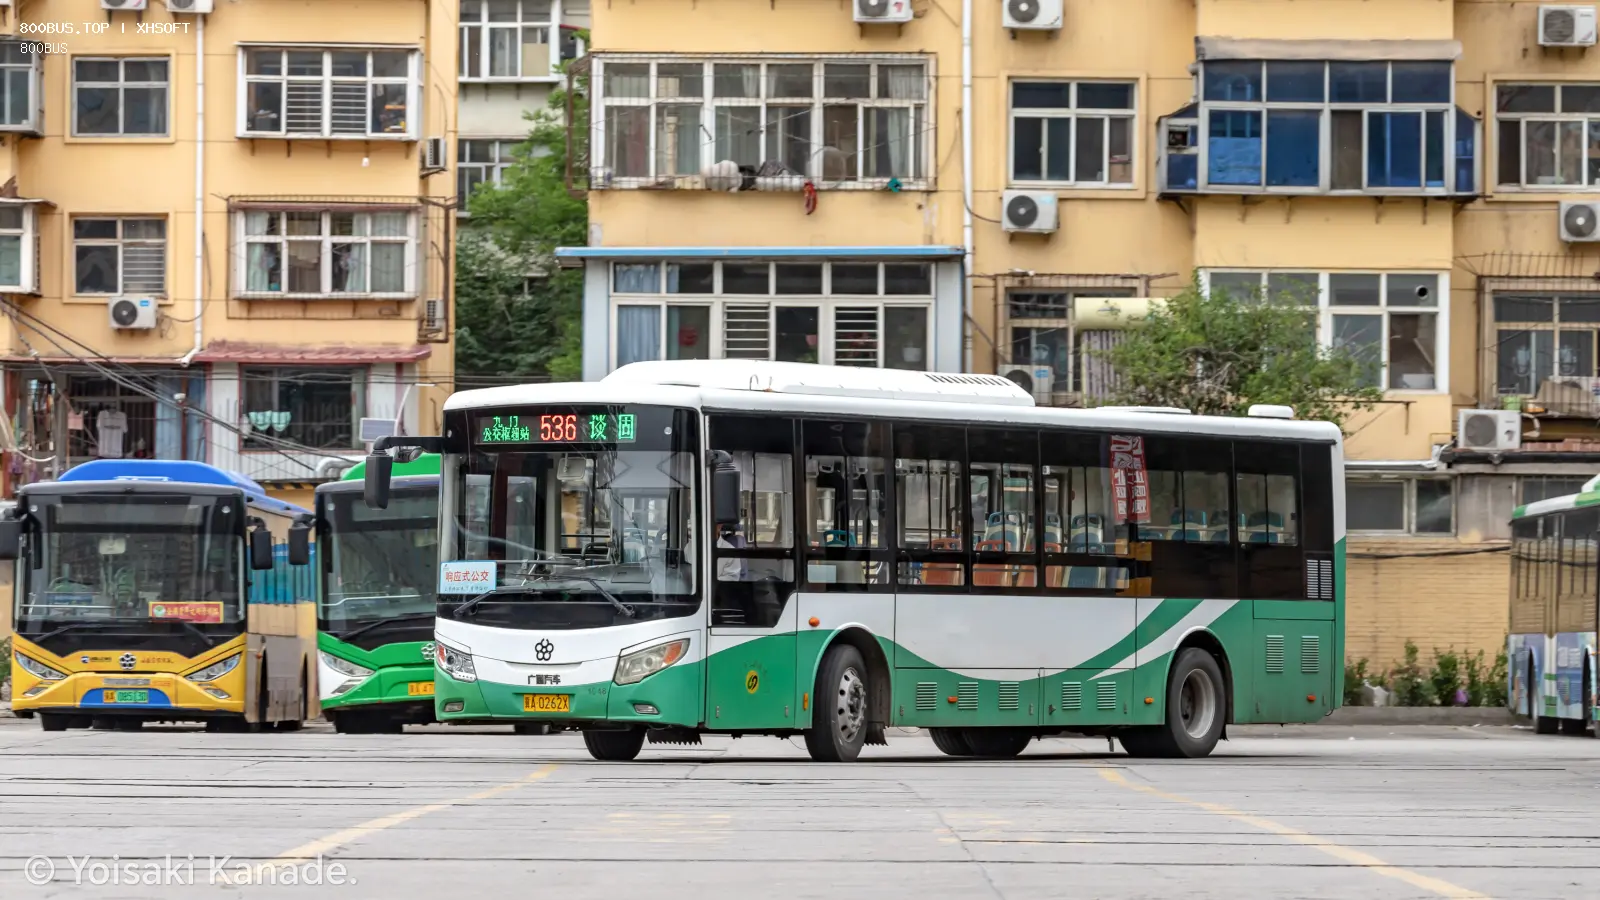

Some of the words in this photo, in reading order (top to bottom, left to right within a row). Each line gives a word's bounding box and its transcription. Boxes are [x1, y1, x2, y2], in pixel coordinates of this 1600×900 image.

[482, 426, 530, 441] 公交枢纽站
[540, 414, 577, 441] 536
[588, 413, 634, 440] 谈固
[445, 569, 489, 582] 响应式公交
